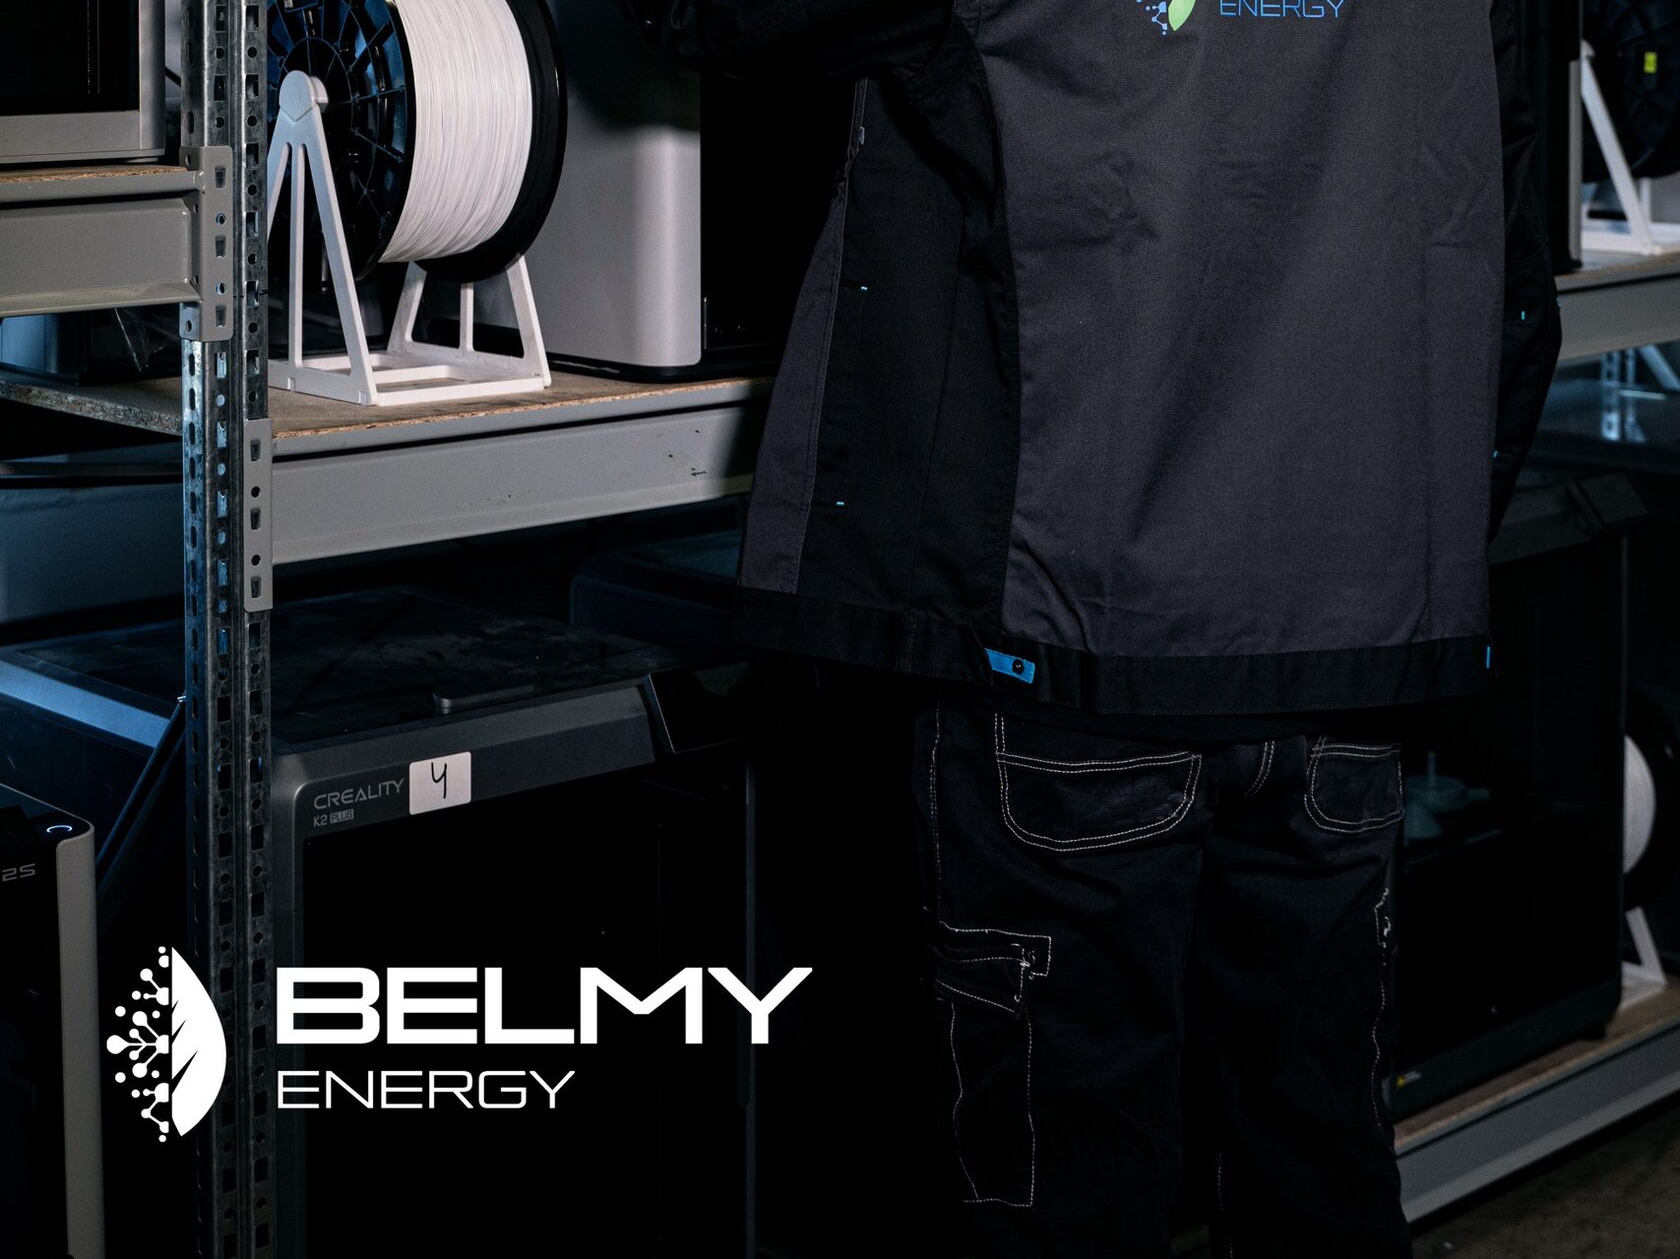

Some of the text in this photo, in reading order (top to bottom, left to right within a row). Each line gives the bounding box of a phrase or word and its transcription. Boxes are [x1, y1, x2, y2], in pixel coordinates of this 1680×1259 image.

[314, 778, 404, 810] CREALITY
[313, 809, 355, 828] K2 PLUS
